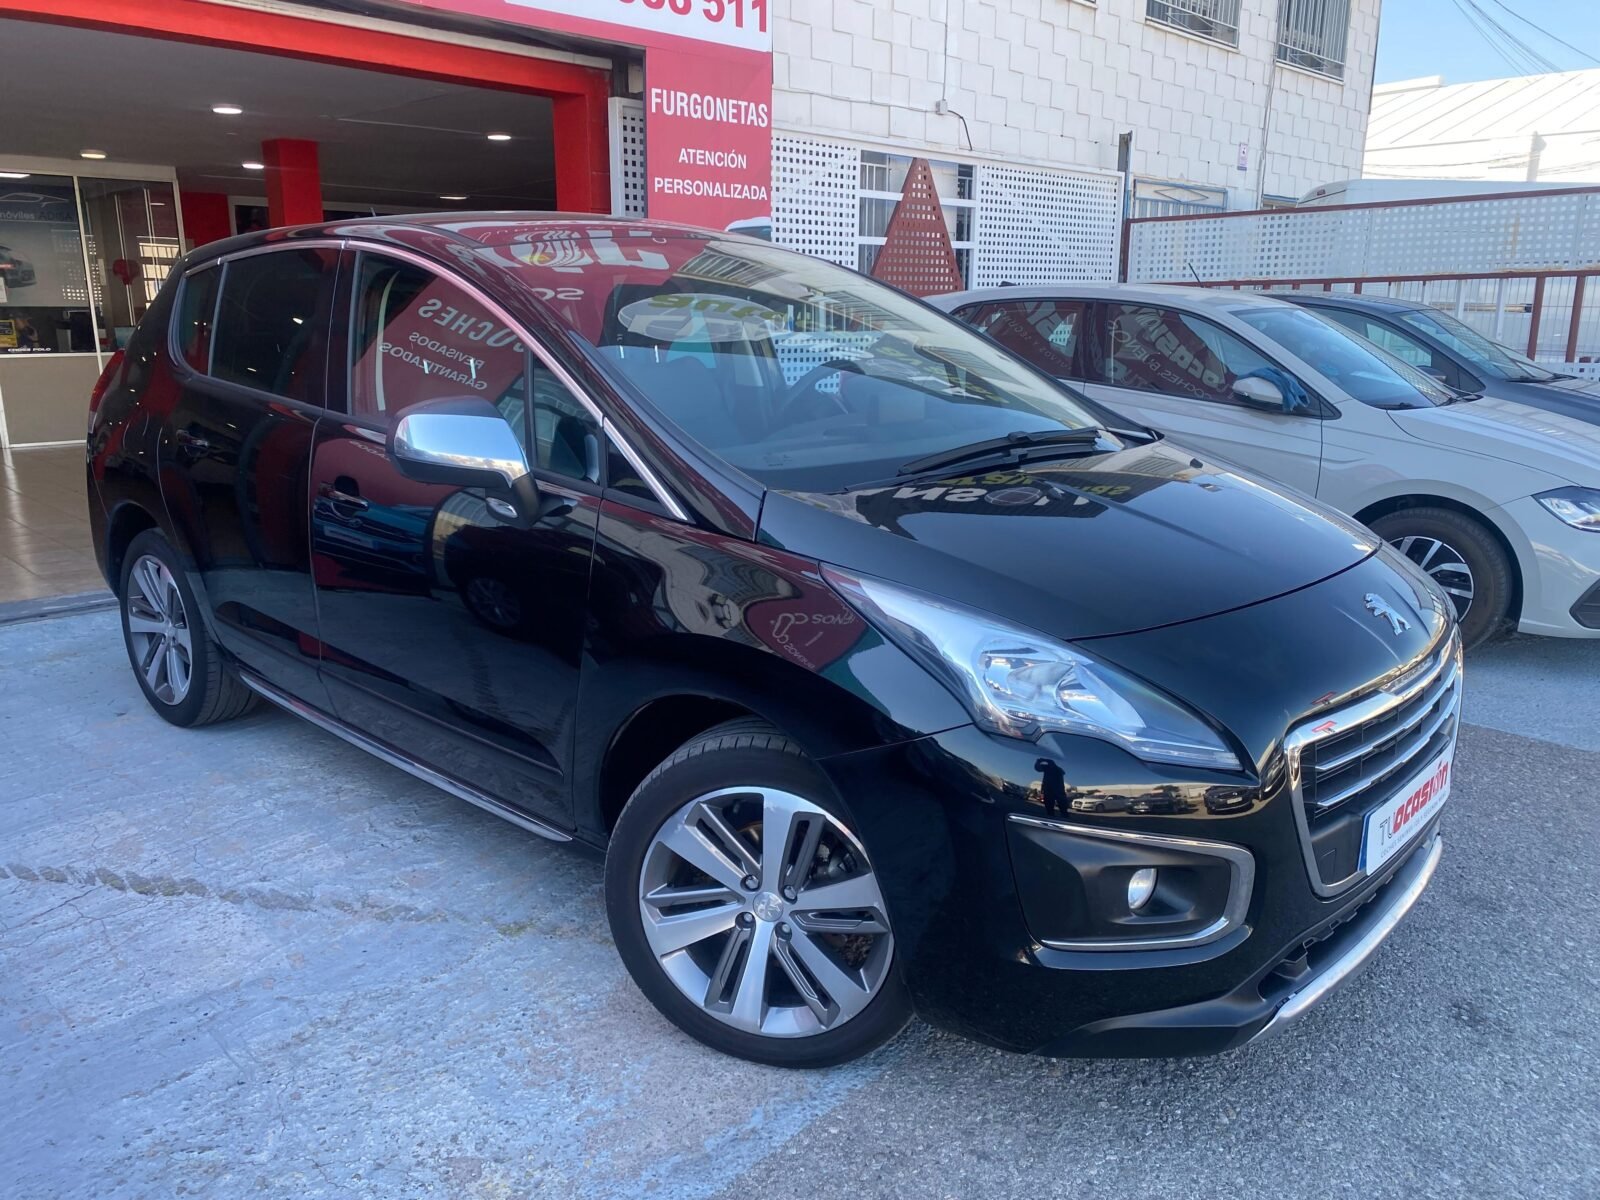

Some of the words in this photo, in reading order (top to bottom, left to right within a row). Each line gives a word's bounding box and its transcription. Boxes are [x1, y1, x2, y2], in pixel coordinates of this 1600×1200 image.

[651, 87, 768, 128] FURGONETAS
[678, 148, 747, 169] ATENCIÓN
[654, 177, 768, 200] PERSONALIZADA
